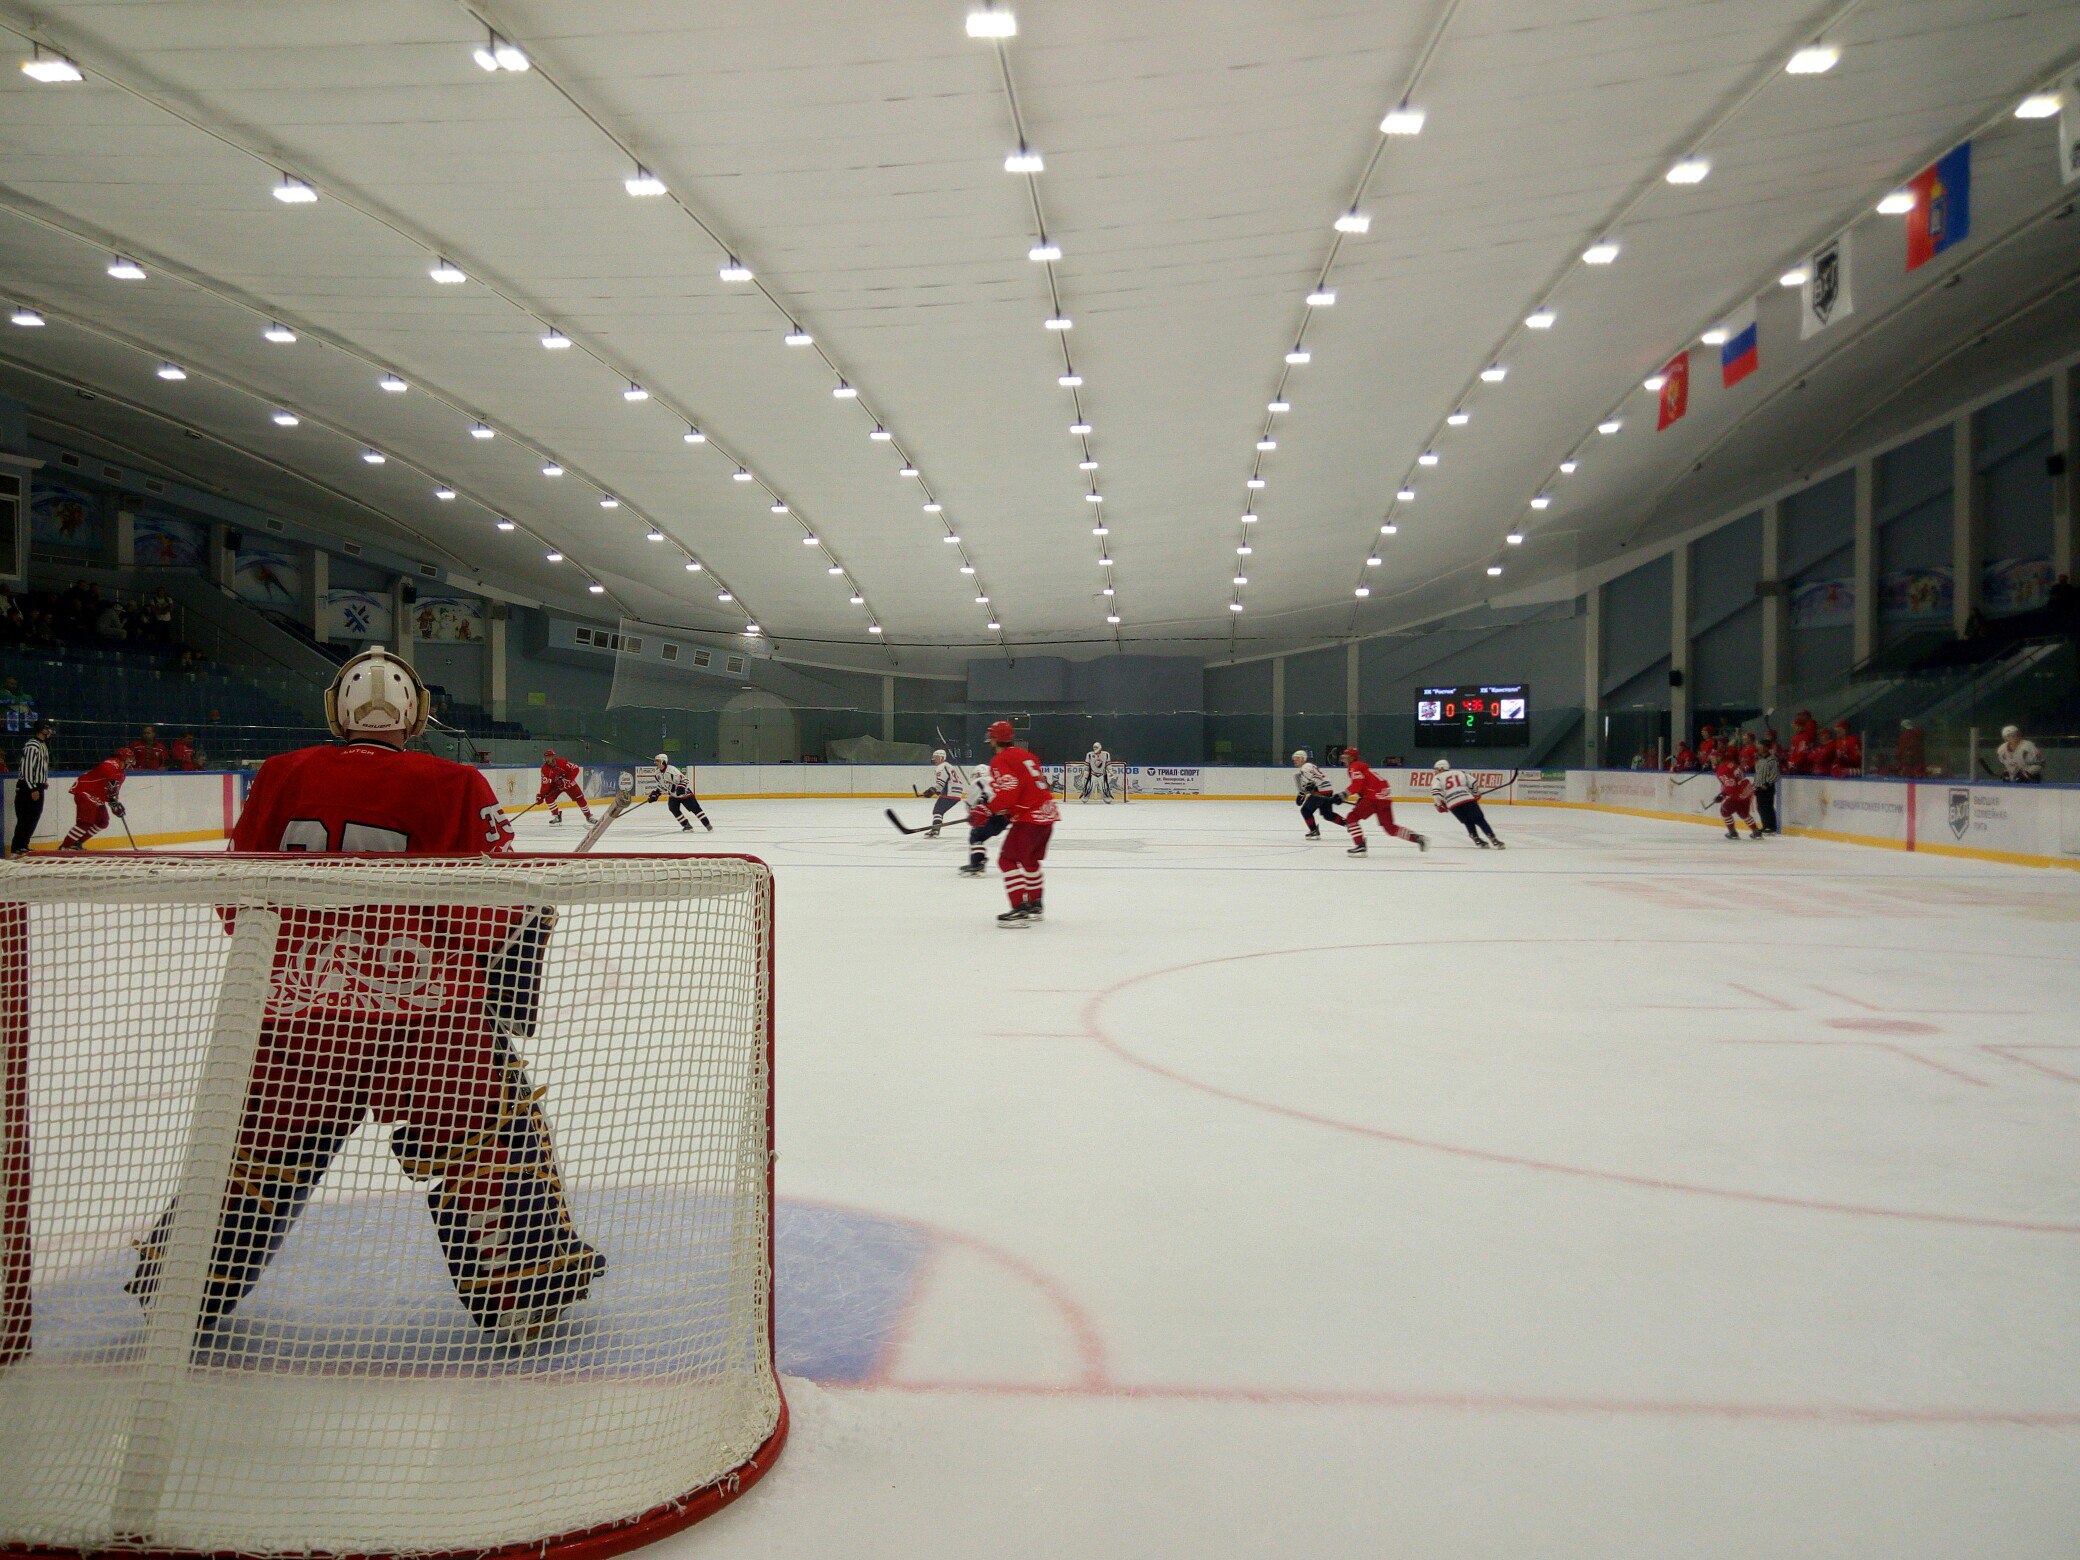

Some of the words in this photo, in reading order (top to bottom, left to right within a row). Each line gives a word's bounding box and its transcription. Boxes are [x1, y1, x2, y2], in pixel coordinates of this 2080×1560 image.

[1446, 703, 1455, 717] 0
[1491, 702, 1499, 717] 0
[1466, 715, 1474, 727] 2
[480, 803, 516, 843] 35
